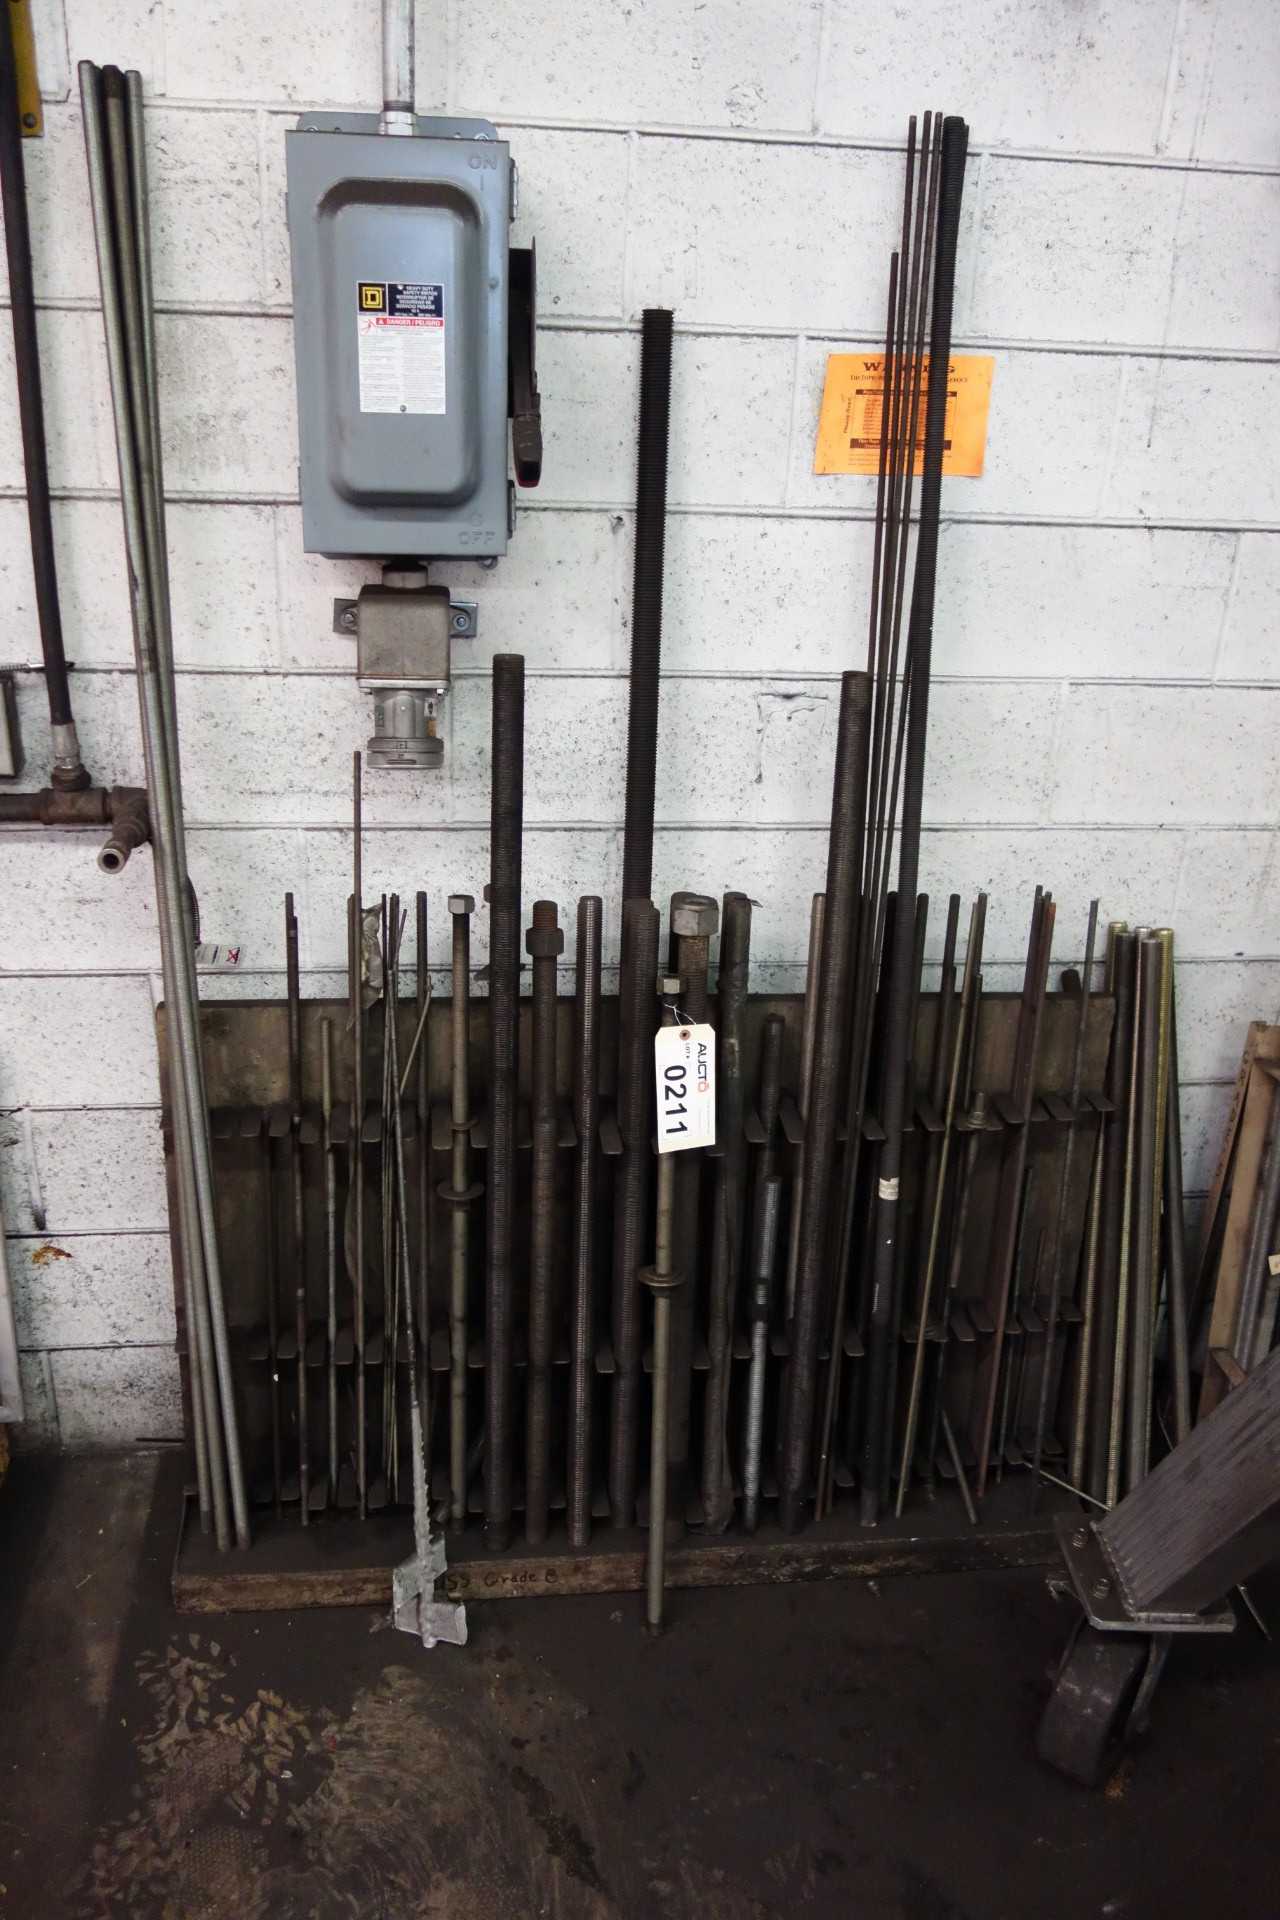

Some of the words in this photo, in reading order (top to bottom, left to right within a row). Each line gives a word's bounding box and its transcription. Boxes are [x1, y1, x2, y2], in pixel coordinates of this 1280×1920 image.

[467, 153, 497, 170] ON
[458, 530, 496, 545] OFF
[664, 1065, 688, 1134] 0211
